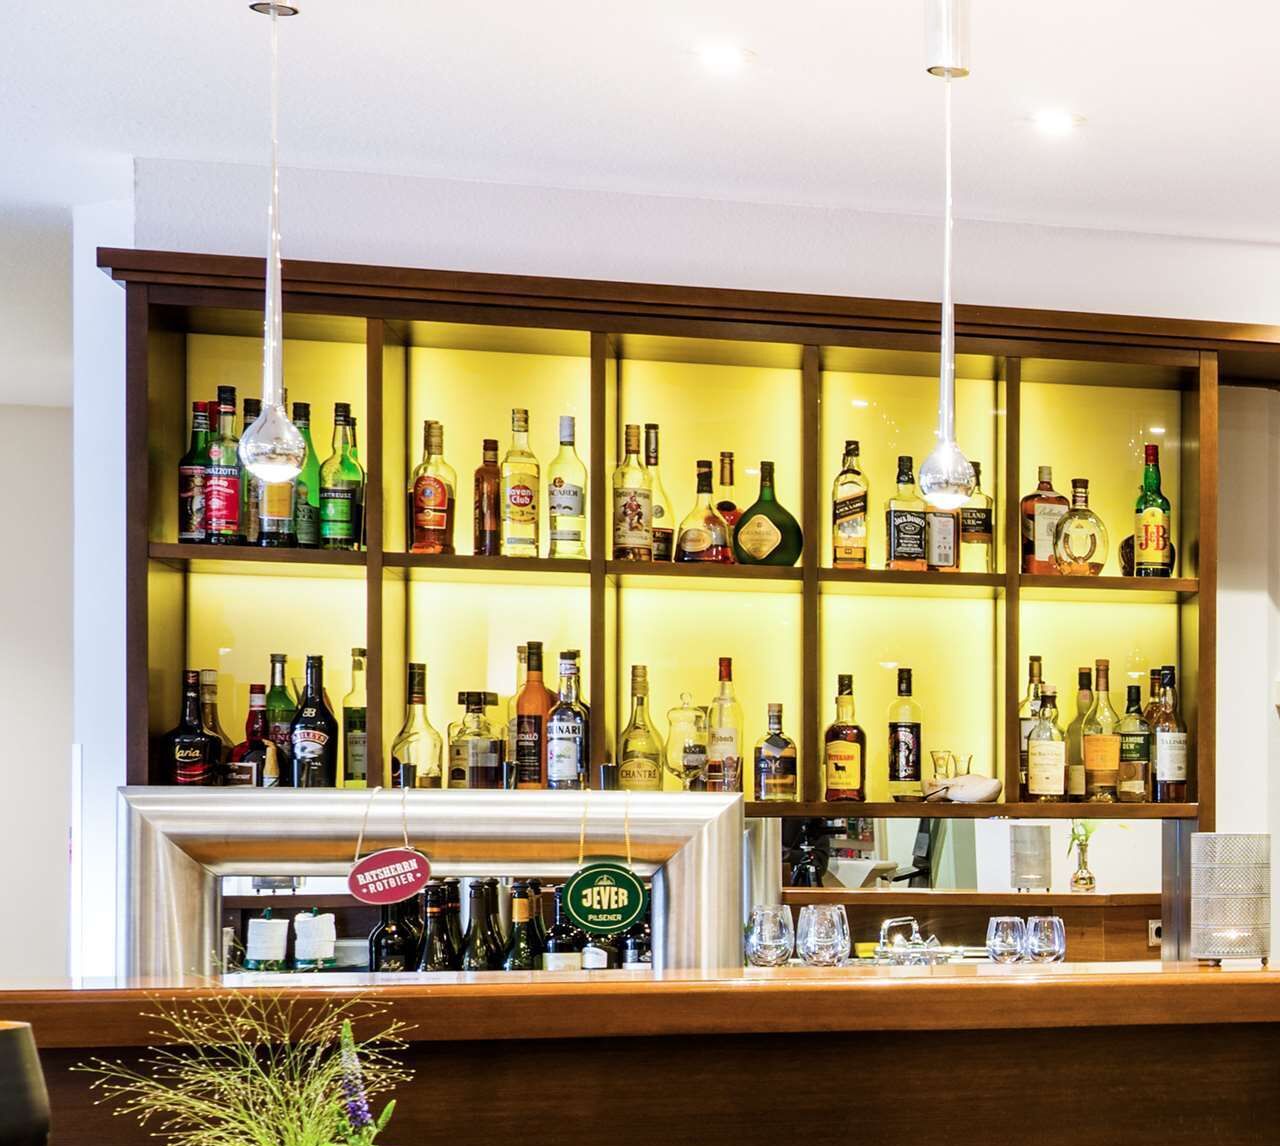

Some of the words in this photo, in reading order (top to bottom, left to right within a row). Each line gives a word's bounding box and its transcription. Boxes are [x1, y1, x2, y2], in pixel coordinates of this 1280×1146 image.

[356, 858, 418, 886] RATSHERRN
[369, 873, 415, 894] ROTBIER
[582, 886, 628, 910] JEVER
[588, 913, 622, 922] PILSENER
